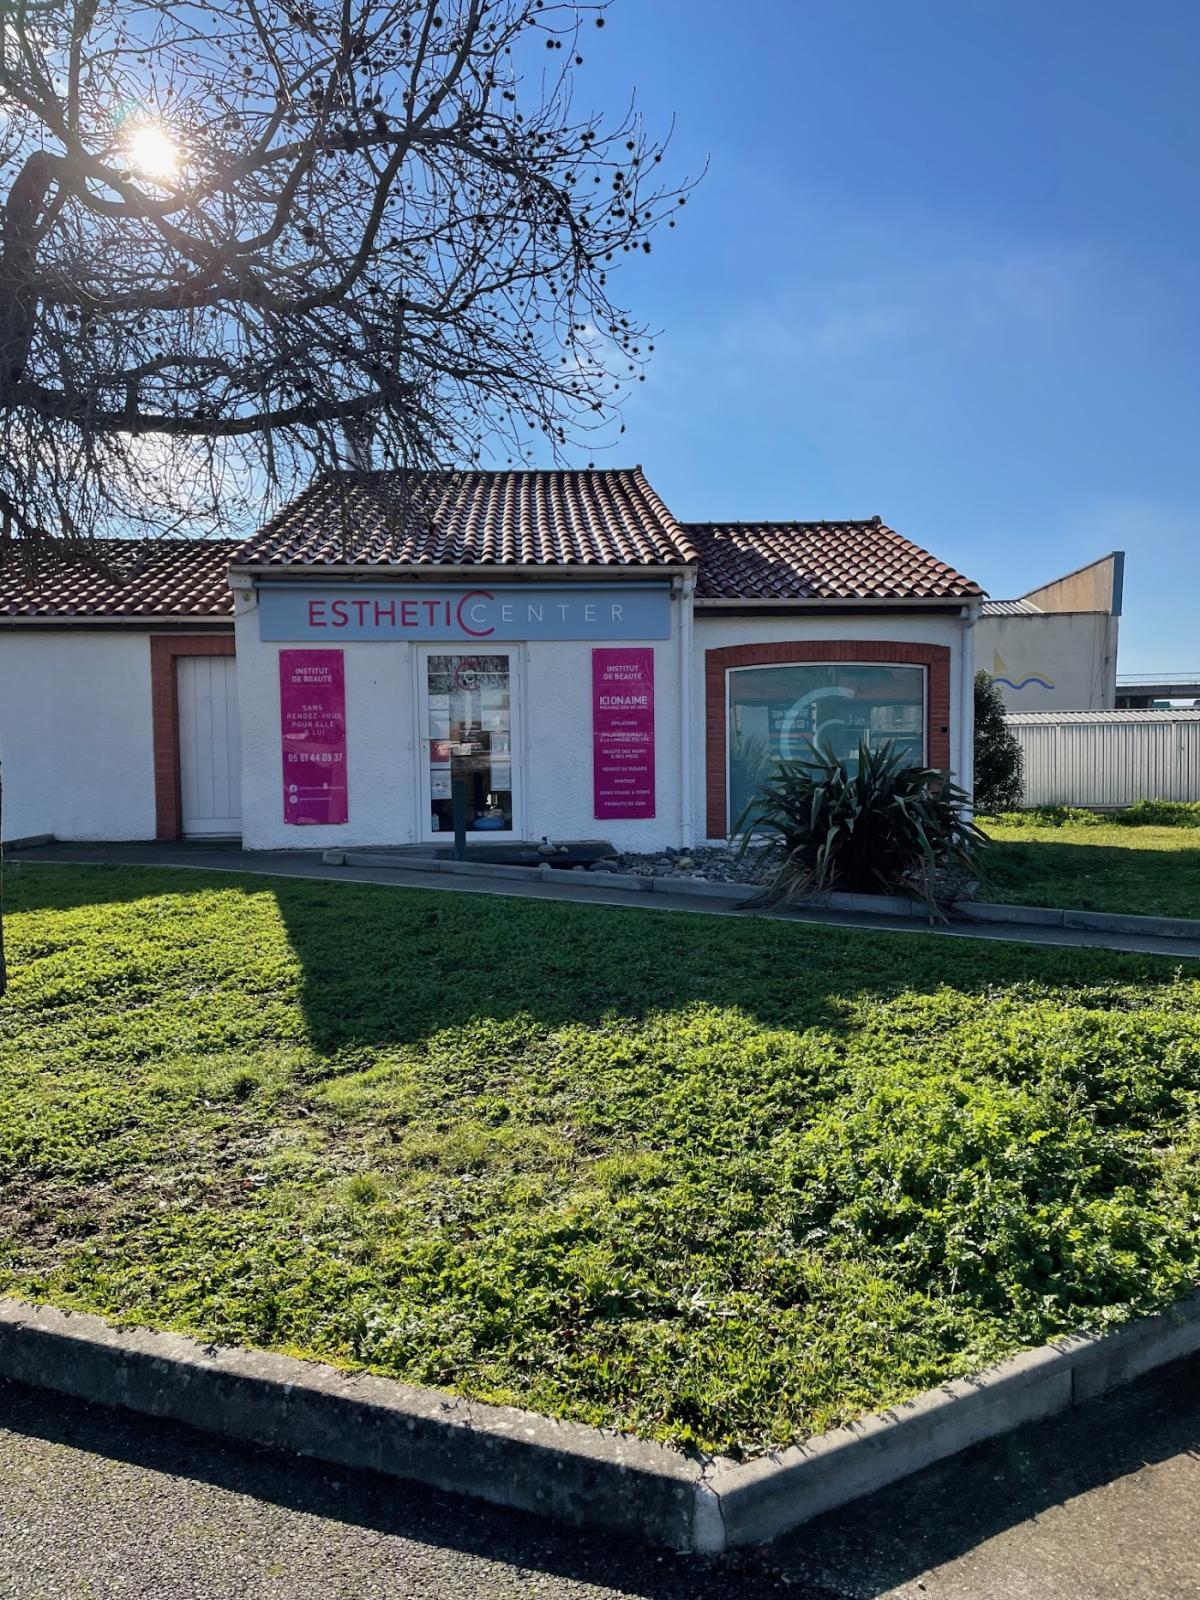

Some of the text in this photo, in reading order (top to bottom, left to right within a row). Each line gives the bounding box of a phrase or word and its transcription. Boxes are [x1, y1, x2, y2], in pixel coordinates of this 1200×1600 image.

[295, 667, 329, 675] INSTITUT
[606, 665, 640, 673] INSTITUT
[291, 675, 302, 683] DE
[610, 696, 624, 705] ON
[624, 695, 648, 705] AIME
[302, 704, 324, 712] SANS
[288, 753, 299, 762] 05
[310, 753, 321, 762] 44
[333, 753, 343, 762] 37
